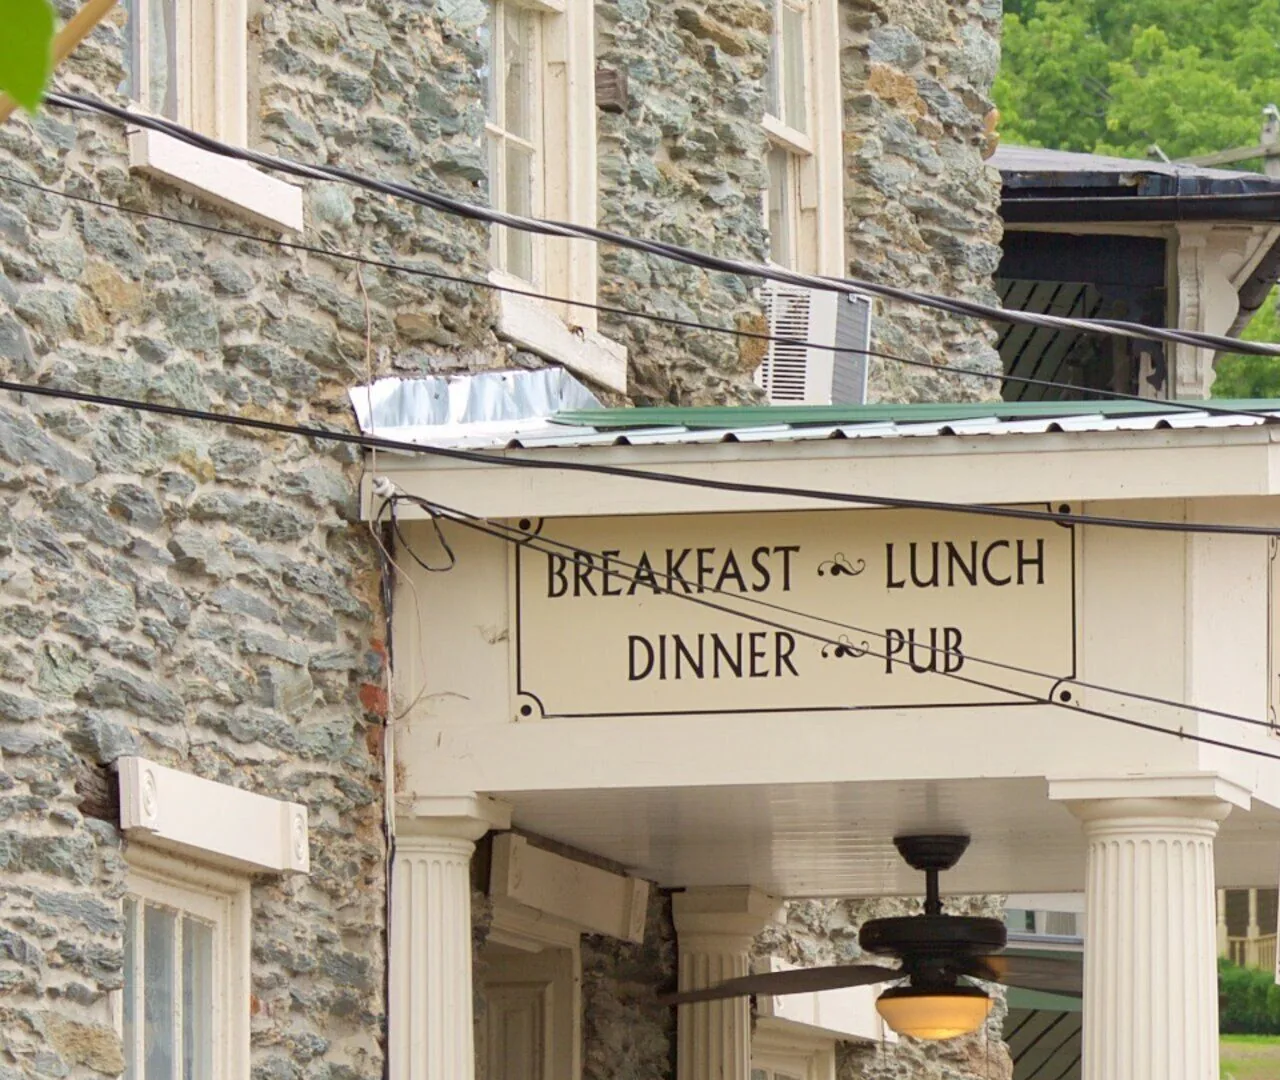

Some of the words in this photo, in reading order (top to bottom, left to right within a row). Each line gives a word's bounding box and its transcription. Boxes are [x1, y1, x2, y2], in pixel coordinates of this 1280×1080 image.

[546, 545, 800, 599] BREAKFAST
[885, 538, 1045, 588] LUNCH
[628, 631, 800, 681] DINNER
[885, 627, 965, 673] PUB
